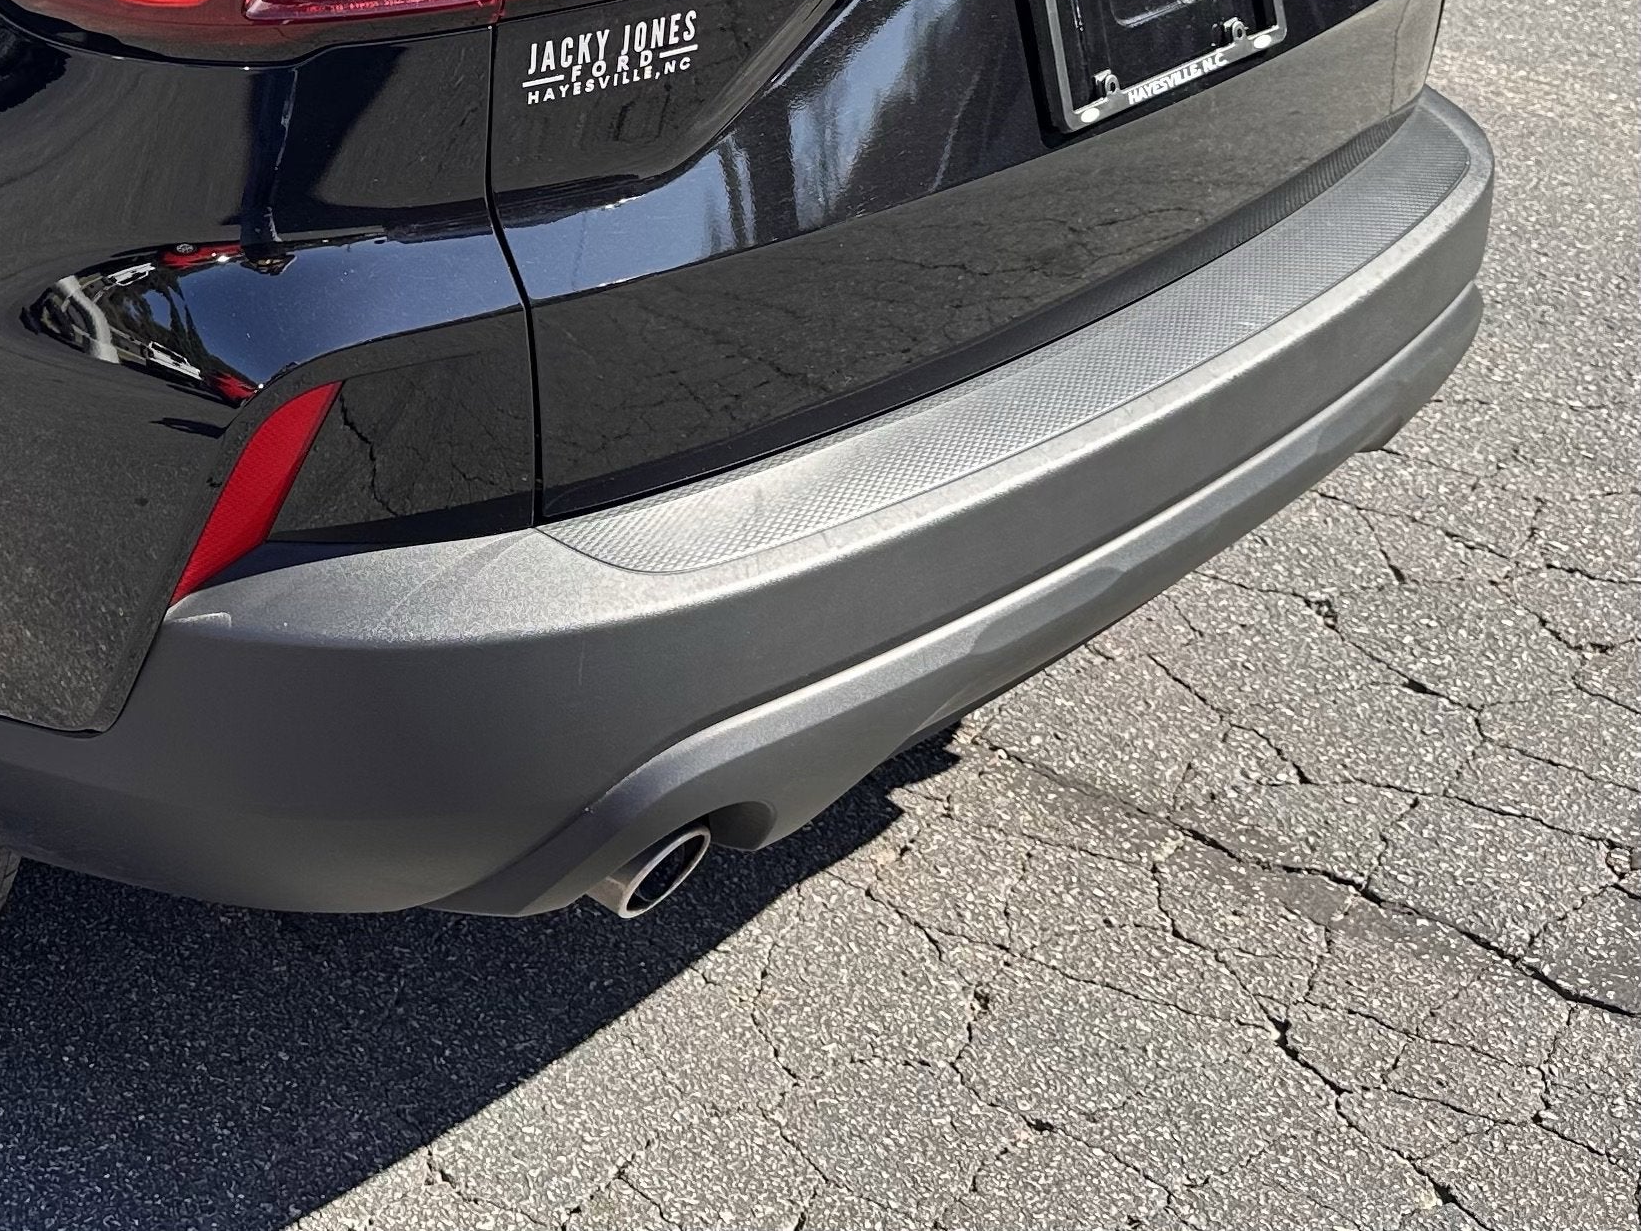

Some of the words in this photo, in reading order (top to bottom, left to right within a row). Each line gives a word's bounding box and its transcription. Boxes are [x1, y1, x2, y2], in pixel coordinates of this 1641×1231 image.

[527, 28, 610, 75] JACKY
[620, 10, 698, 55] JONES
[571, 49, 653, 83] FORD
